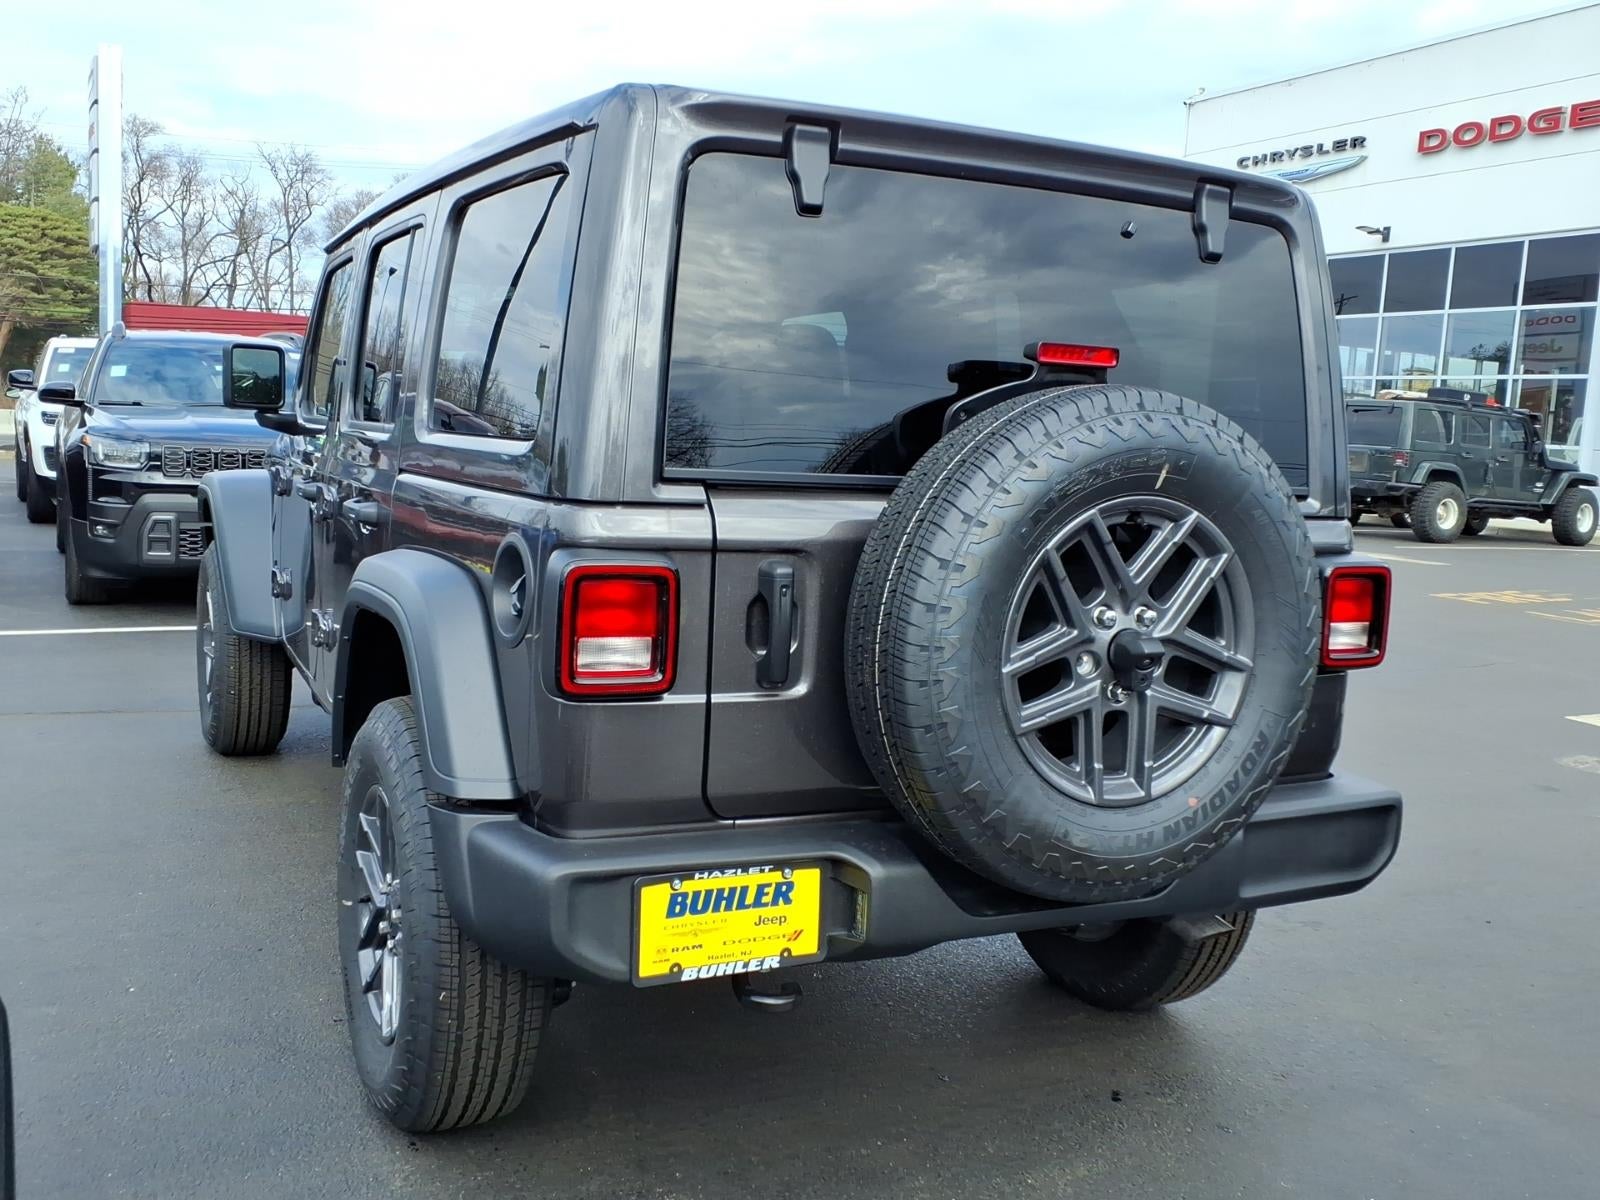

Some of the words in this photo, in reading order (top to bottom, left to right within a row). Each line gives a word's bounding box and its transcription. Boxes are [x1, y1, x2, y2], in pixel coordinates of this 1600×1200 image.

[1417, 98, 1600, 155] DODGE
[1236, 136, 1367, 169] CHRYSLER
[1161, 729, 1270, 843] ROADIAN
[694, 865, 774, 880] HAZLET
[665, 880, 795, 919] BUHLER
[754, 914, 788, 927] Jeep
[671, 943, 704, 953] RAM
[680, 955, 782, 982] BUHLER
